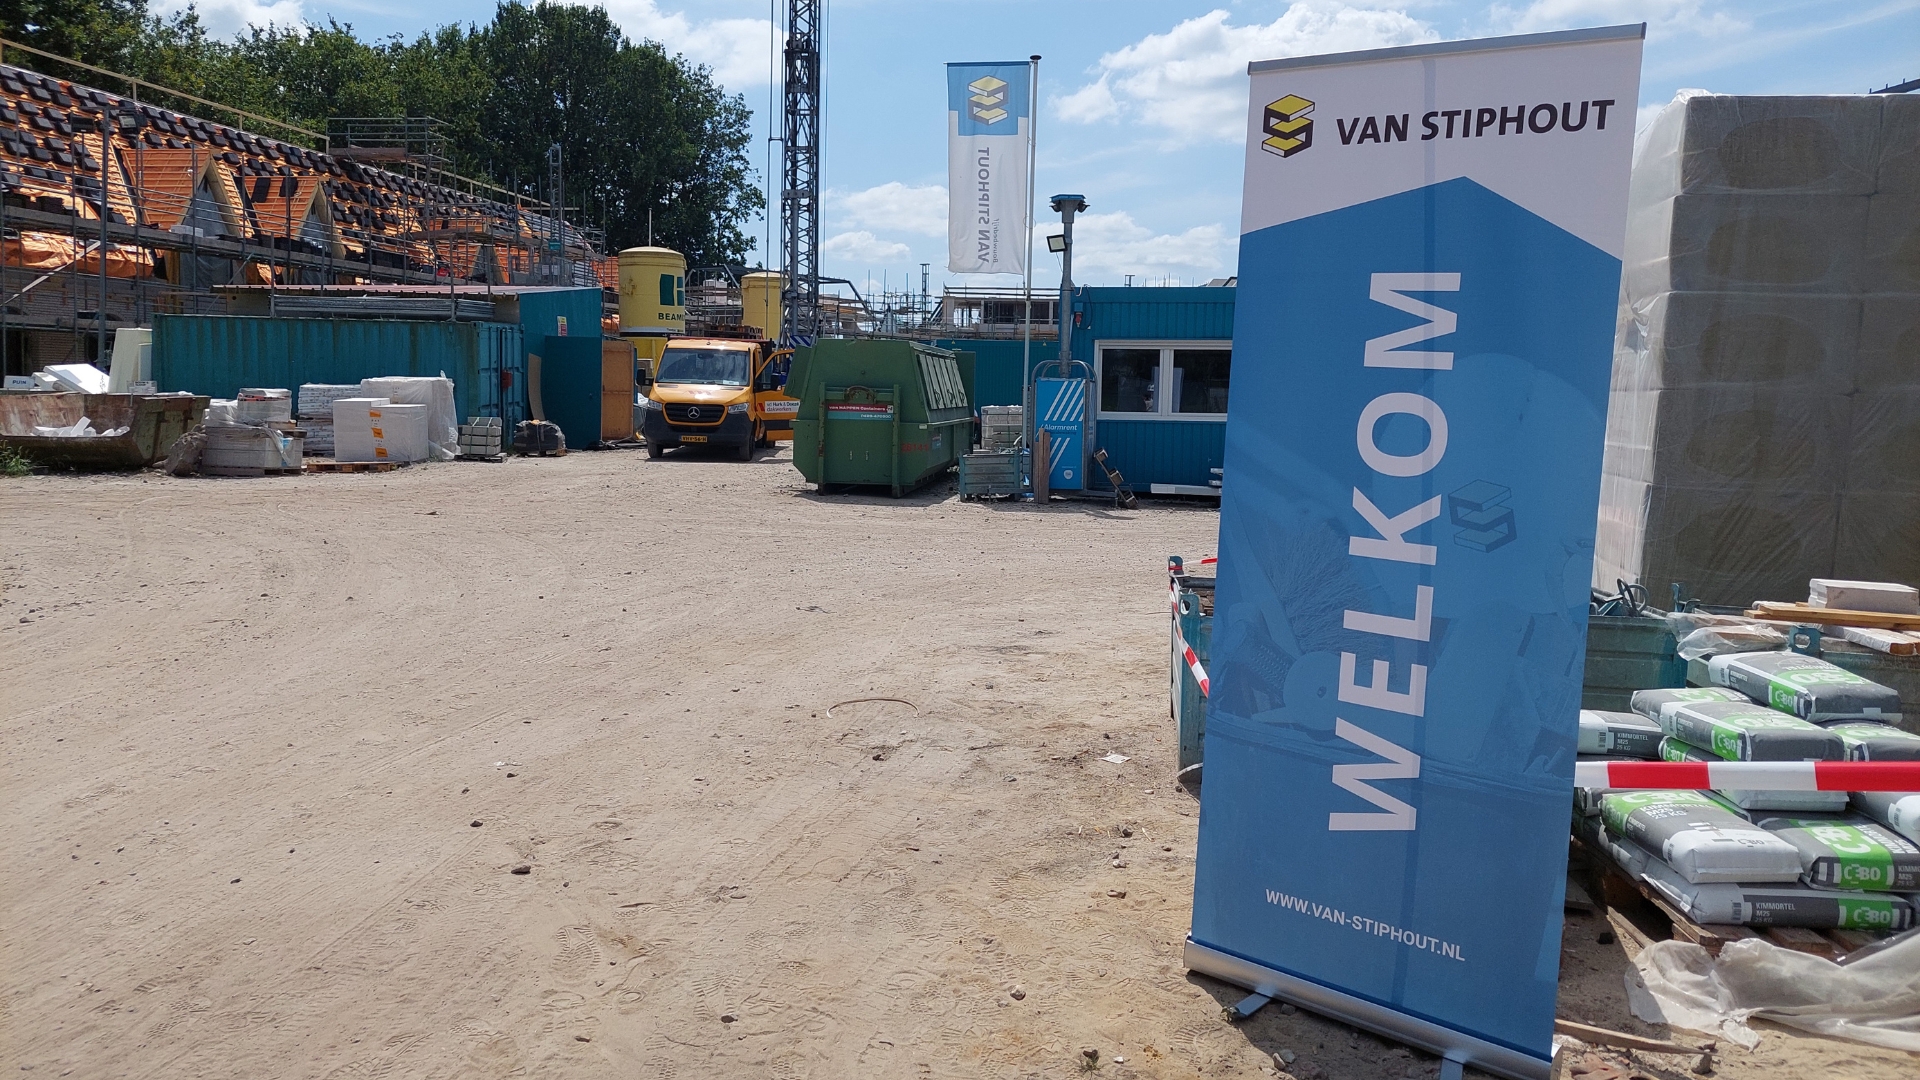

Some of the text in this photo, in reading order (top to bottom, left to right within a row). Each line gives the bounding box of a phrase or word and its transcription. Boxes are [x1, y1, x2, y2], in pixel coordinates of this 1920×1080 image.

[1336, 99, 1615, 145] VAN STIPHOUT
[1328, 272, 1462, 831] WELKOM
[1617, 732, 1649, 741] KIMMORTEL
[1265, 888, 1466, 962] WWW.VAN-STIPHOUT.NL
[1755, 902, 1796, 911] KIMMORTEL
